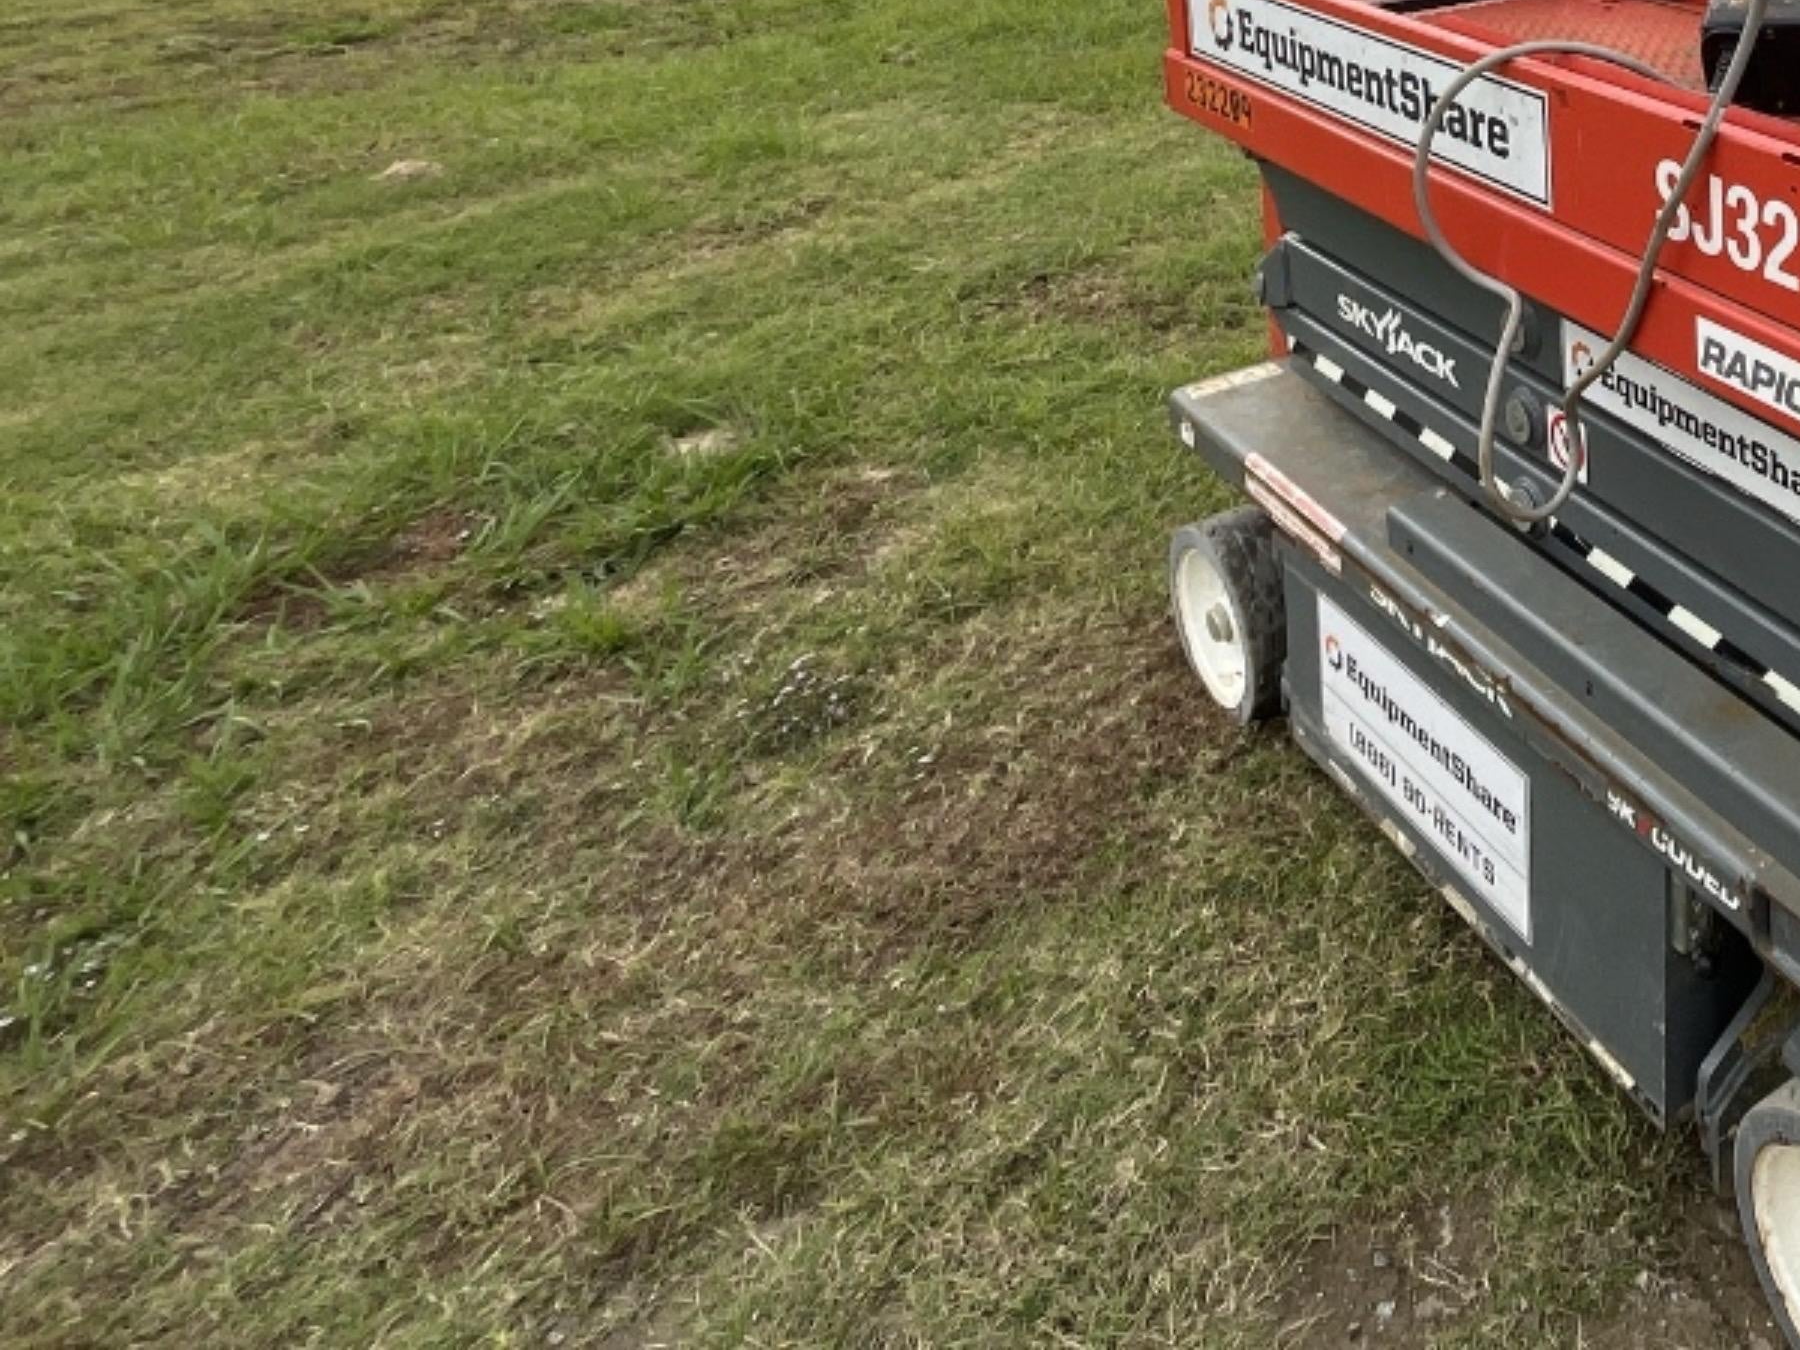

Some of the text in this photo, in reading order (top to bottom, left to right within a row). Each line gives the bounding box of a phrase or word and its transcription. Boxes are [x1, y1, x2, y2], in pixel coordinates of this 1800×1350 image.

[1237, 9, 1511, 159] EquipmentShare
[1337, 293, 1461, 389] SKYJACK
[1345, 653, 1517, 834] EquipmentShare
